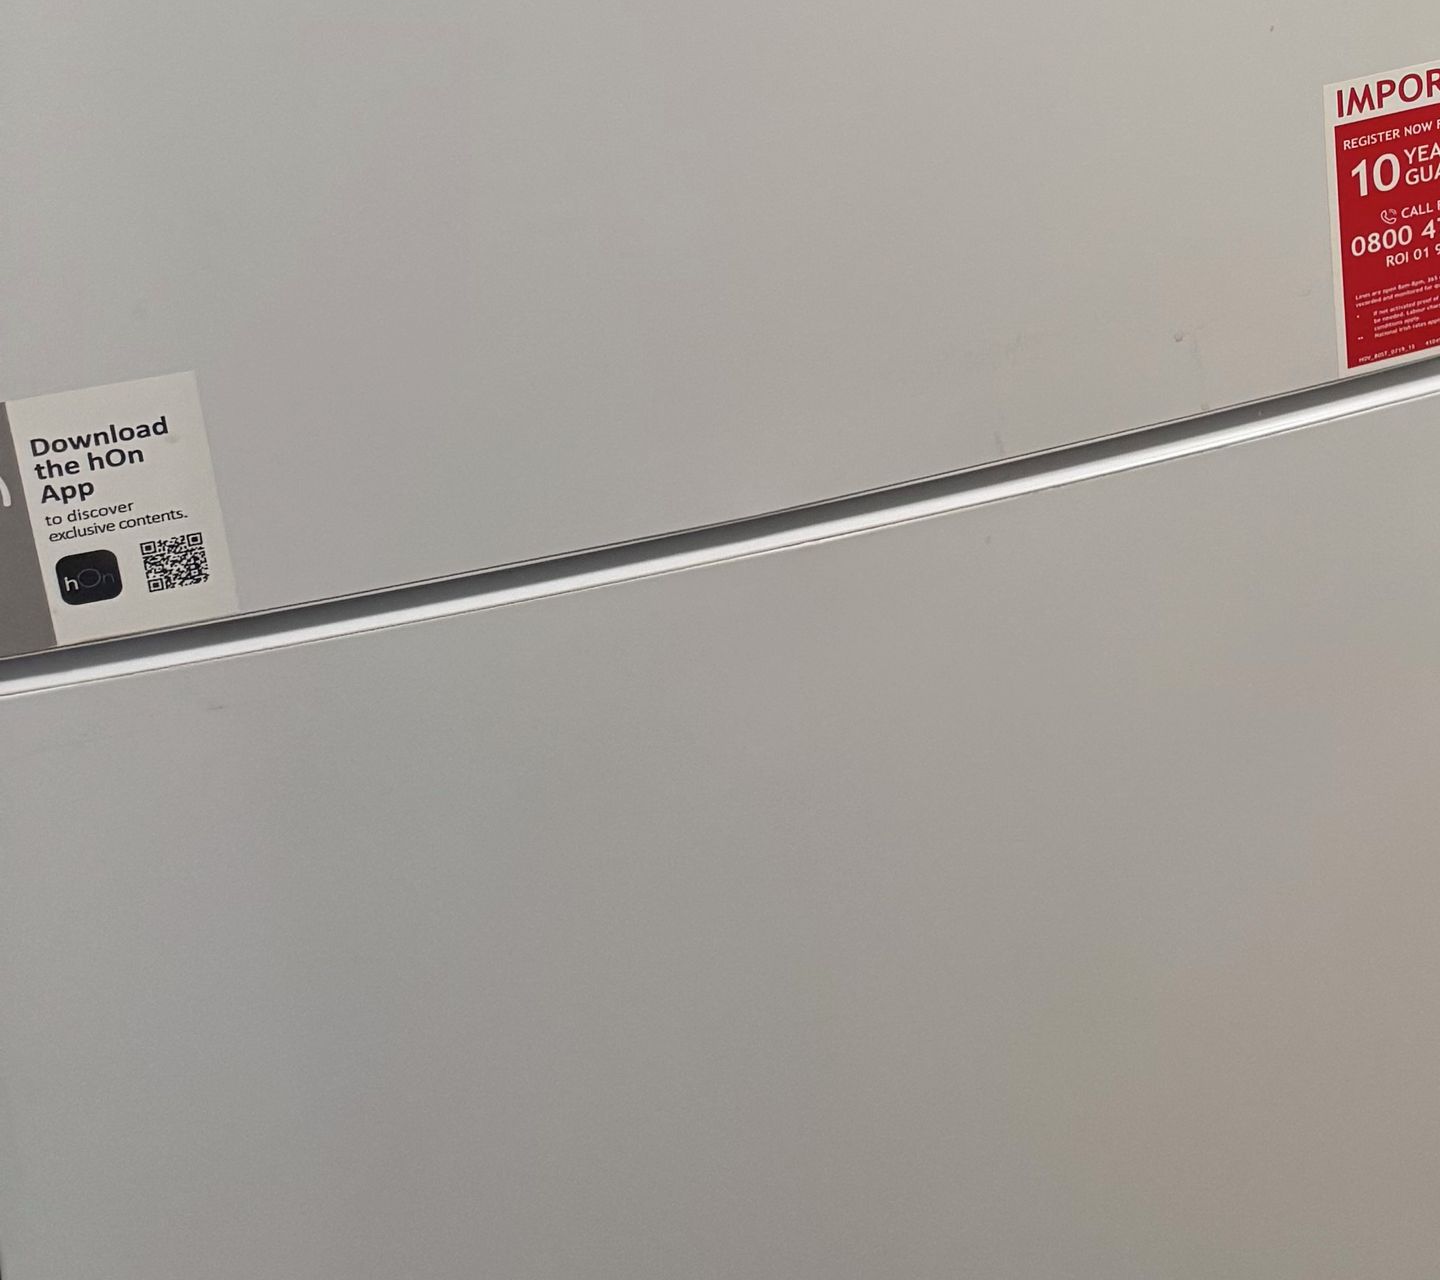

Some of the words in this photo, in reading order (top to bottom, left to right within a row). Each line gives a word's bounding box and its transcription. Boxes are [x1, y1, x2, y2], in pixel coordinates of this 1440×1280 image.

[1343, 129, 1400, 150] REGISTER
[1404, 121, 1433, 139] NOW
[1351, 153, 1400, 197] 10
[1400, 202, 1434, 219] CALL
[1351, 224, 1413, 257] 0800
[1385, 251, 1409, 268] ROI
[1413, 247, 1429, 260] 01
[30, 416, 169, 457] Download
[34, 460, 80, 480] the
[87, 448, 144, 471] hOn
[41, 481, 95, 504] App
[45, 514, 63, 526] to
[67, 501, 134, 523] discover
[48, 521, 116, 542] exclusive
[118, 509, 188, 530] contents.
[63, 568, 116, 593] hOn
